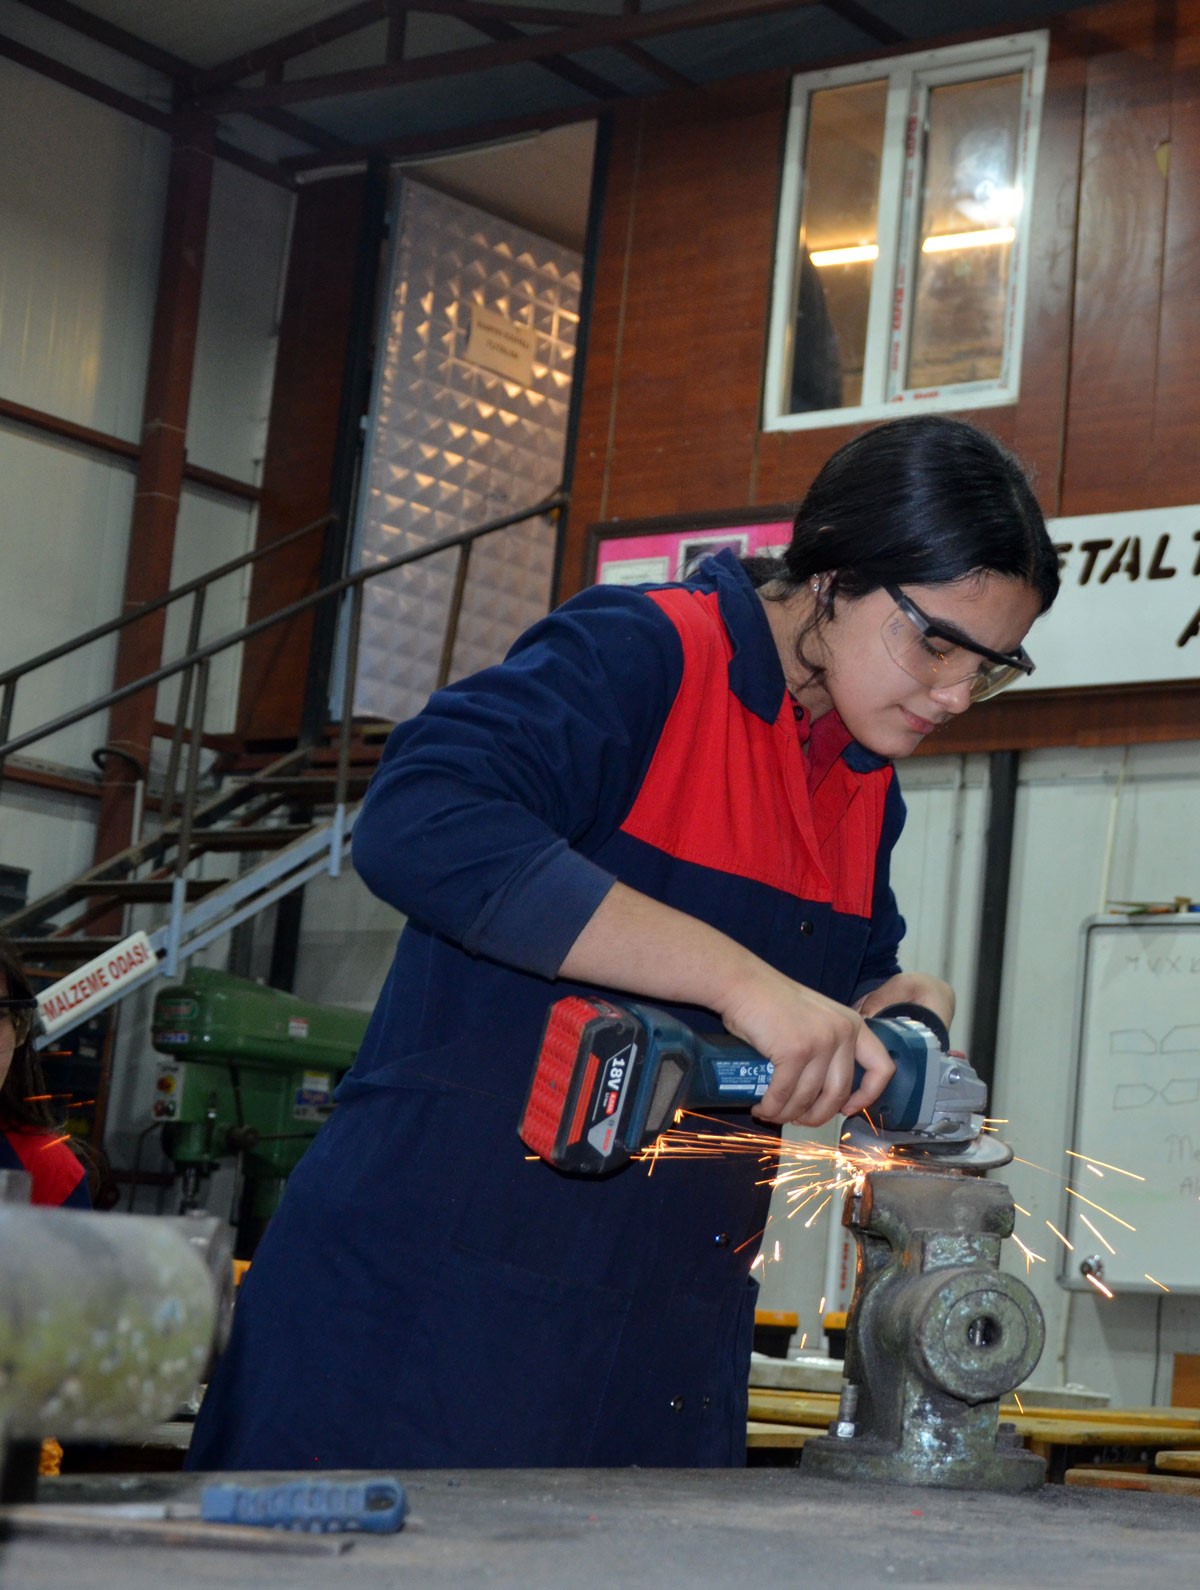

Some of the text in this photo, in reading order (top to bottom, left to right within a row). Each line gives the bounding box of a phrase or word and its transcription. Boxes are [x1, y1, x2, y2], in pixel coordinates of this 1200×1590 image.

[1055, 532, 1177, 587] TAL
[43, 941, 149, 1022] MALZEME ODASI
[607, 1058, 626, 1091] 18V
